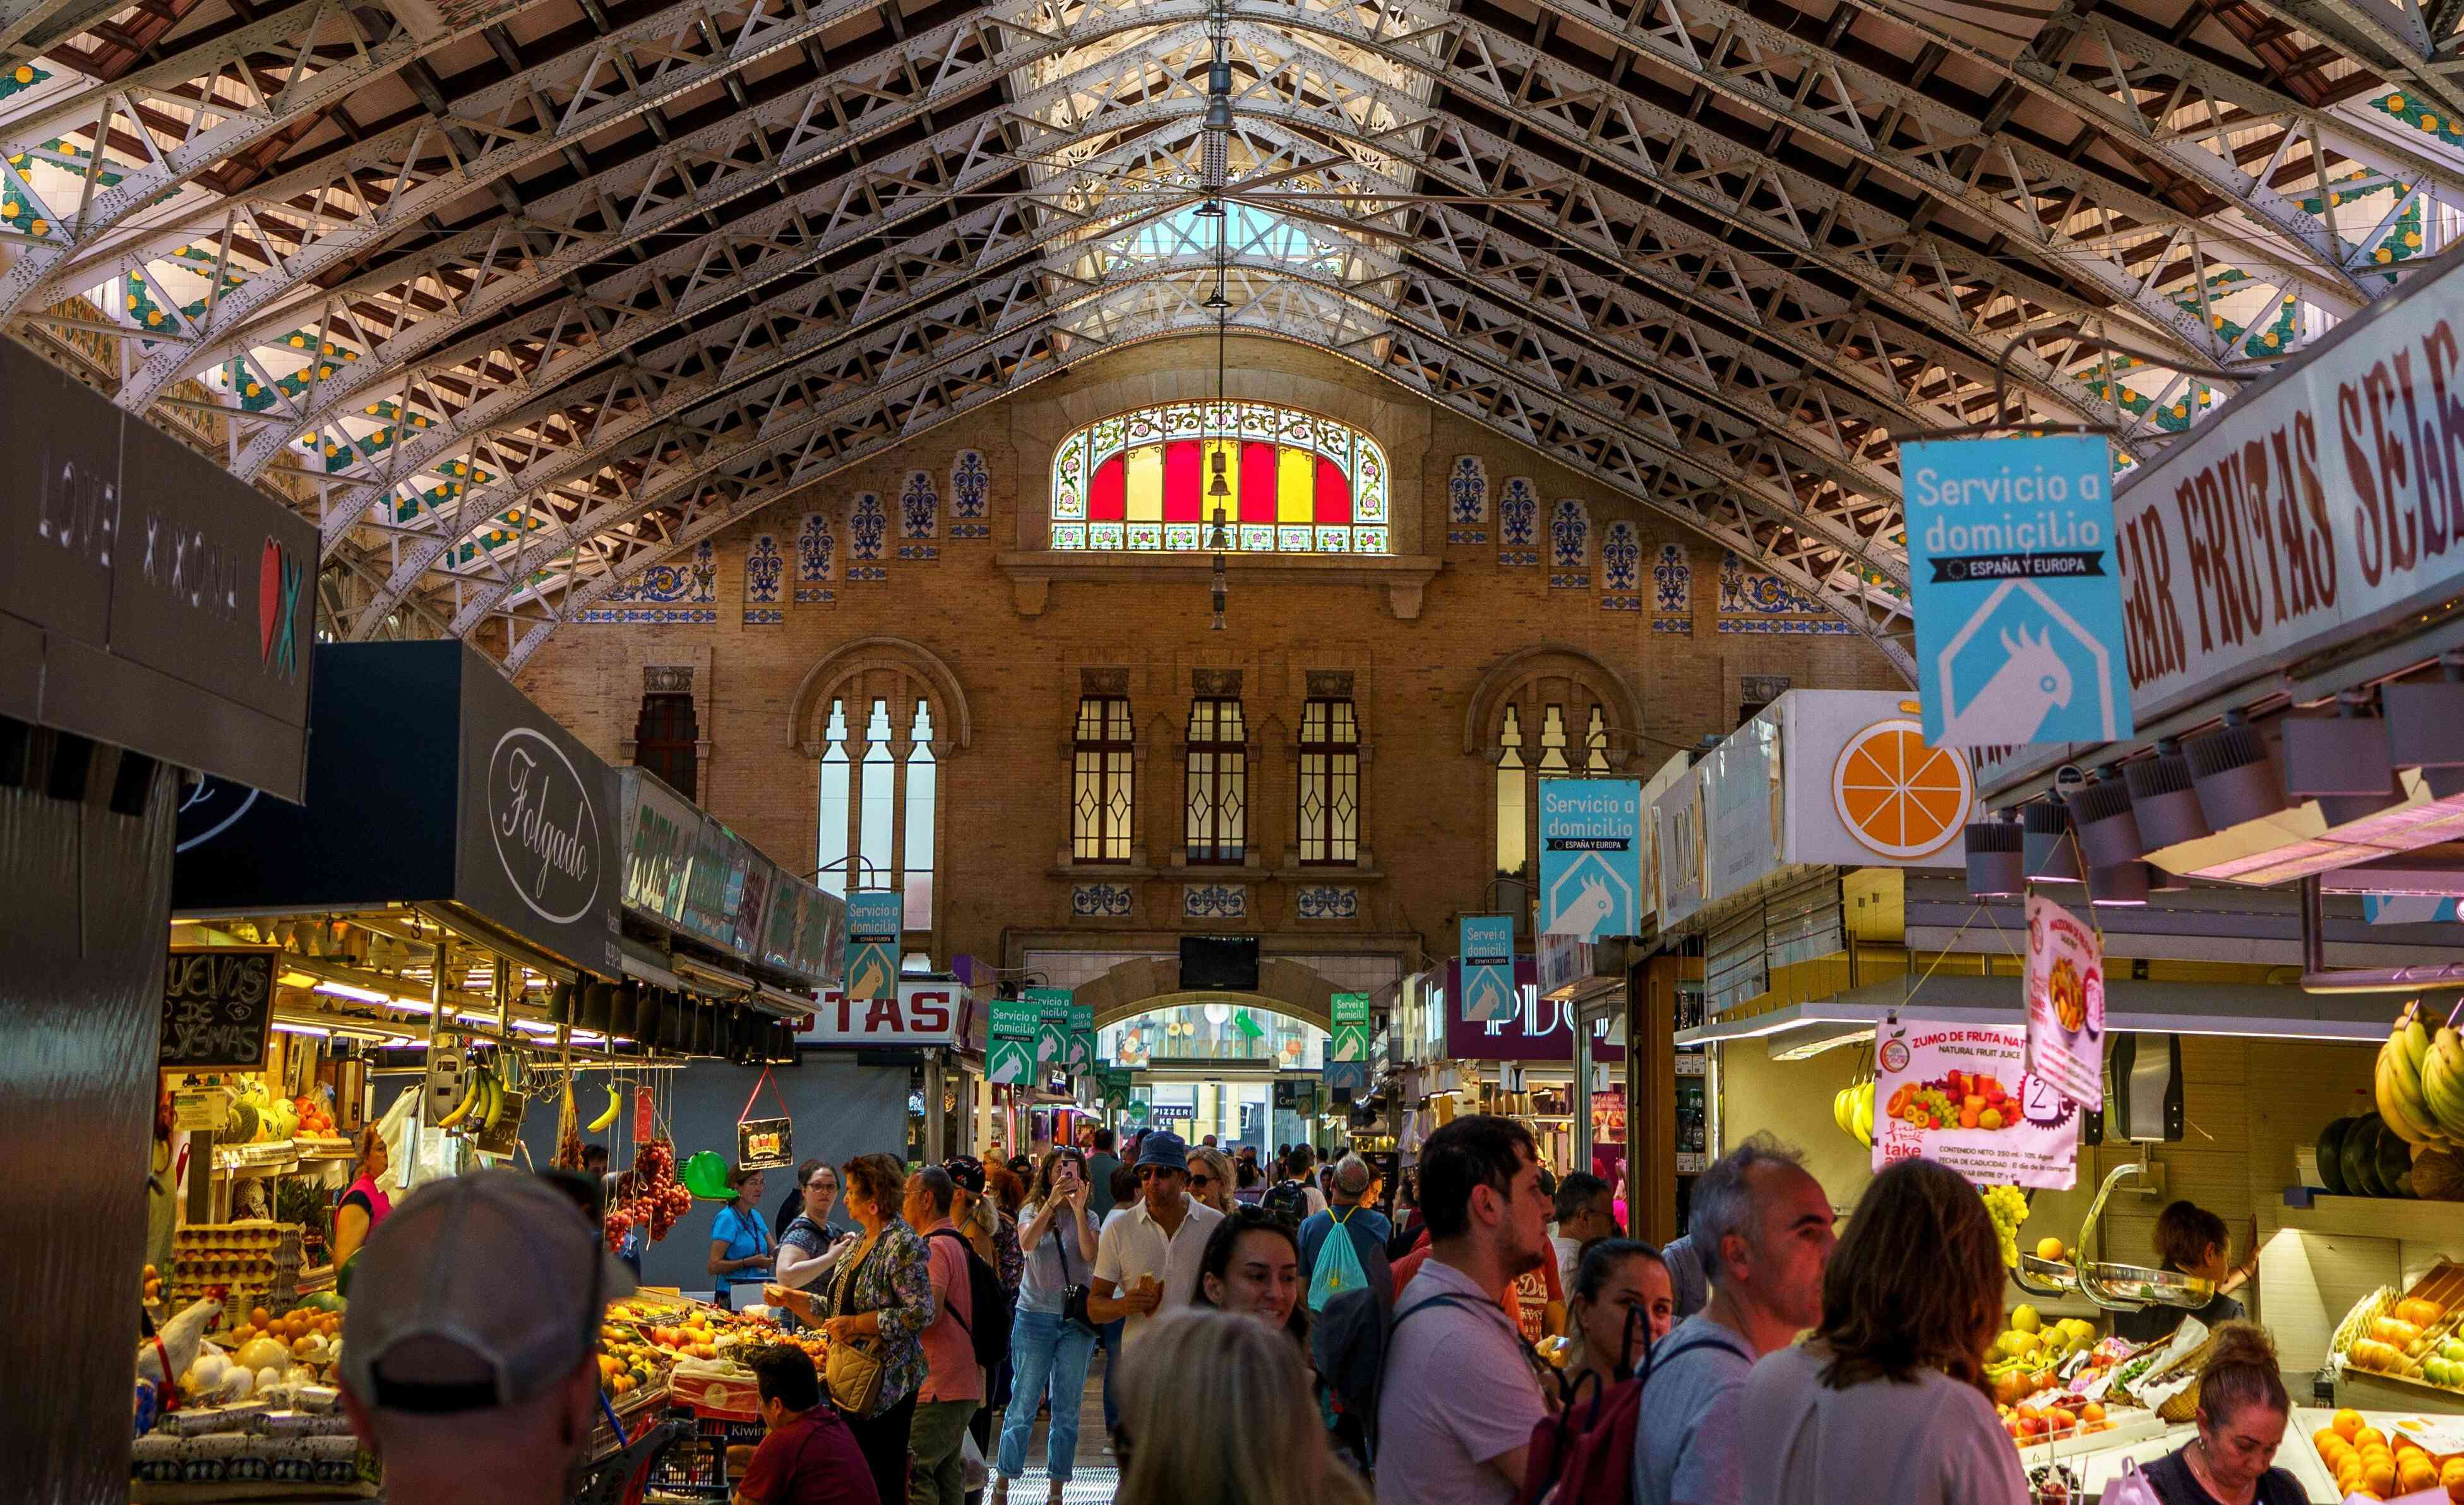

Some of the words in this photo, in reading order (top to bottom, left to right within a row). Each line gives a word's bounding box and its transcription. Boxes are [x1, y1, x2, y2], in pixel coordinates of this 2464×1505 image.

[1916, 465, 2068, 507] Servicio
[2079, 473, 2100, 501] a
[1926, 510, 2100, 553] domicilio
[2175, 410, 2336, 654] FRUTAS
[1970, 556, 2021, 576] ESPAÑA
[2023, 558, 2031, 573] Y
[2034, 557, 2086, 573] EUROPA
[1546, 793, 1618, 813] Servicio
[1624, 799, 1634, 814] a
[503, 747, 589, 899] Folgado
[1548, 817, 1633, 837] domicilio
[1565, 839, 1589, 849] ESPAÑA
[1596, 841, 1622, 849] EUROPA
[850, 903, 890, 917] Servicio
[892, 906, 898, 916] a
[851, 919, 896, 933] domicilio
[1468, 926, 1497, 941] Servei
[1500, 930, 1505, 940] a
[1468, 942, 1506, 957] domicili
[167, 954, 268, 1004] UEVOS
[1041, 1007, 1068, 1017] micilio
[1336, 1000, 1358, 1009] Servei
[993, 1008, 1030, 1021] Servicio
[1032, 1014, 1038, 1022] a
[1336, 1010, 1365, 1019] domicili
[993, 1021, 1036, 1034] domicilio
[1911, 1032, 1947, 1049] ZUMO
[1949, 1031, 1964, 1041] DE
[1966, 1031, 2001, 1043] FRUTA
[2004, 1035, 2027, 1049] NAT
[1939, 1045, 1974, 1056] NATURAL
[1976, 1048, 1997, 1057] FRUIT
[1999, 1051, 2021, 1060] JUICE
[2031, 1077, 2047, 1109] 2
[1884, 1141, 1922, 1158] take
[1939, 1145, 1977, 1154] CONTENIDO
[1939, 1156, 1958, 1165] FECHA
[1970, 1159, 2007, 1168] CADUCIDAD
[1977, 1170, 1995, 1178] ENTRE
